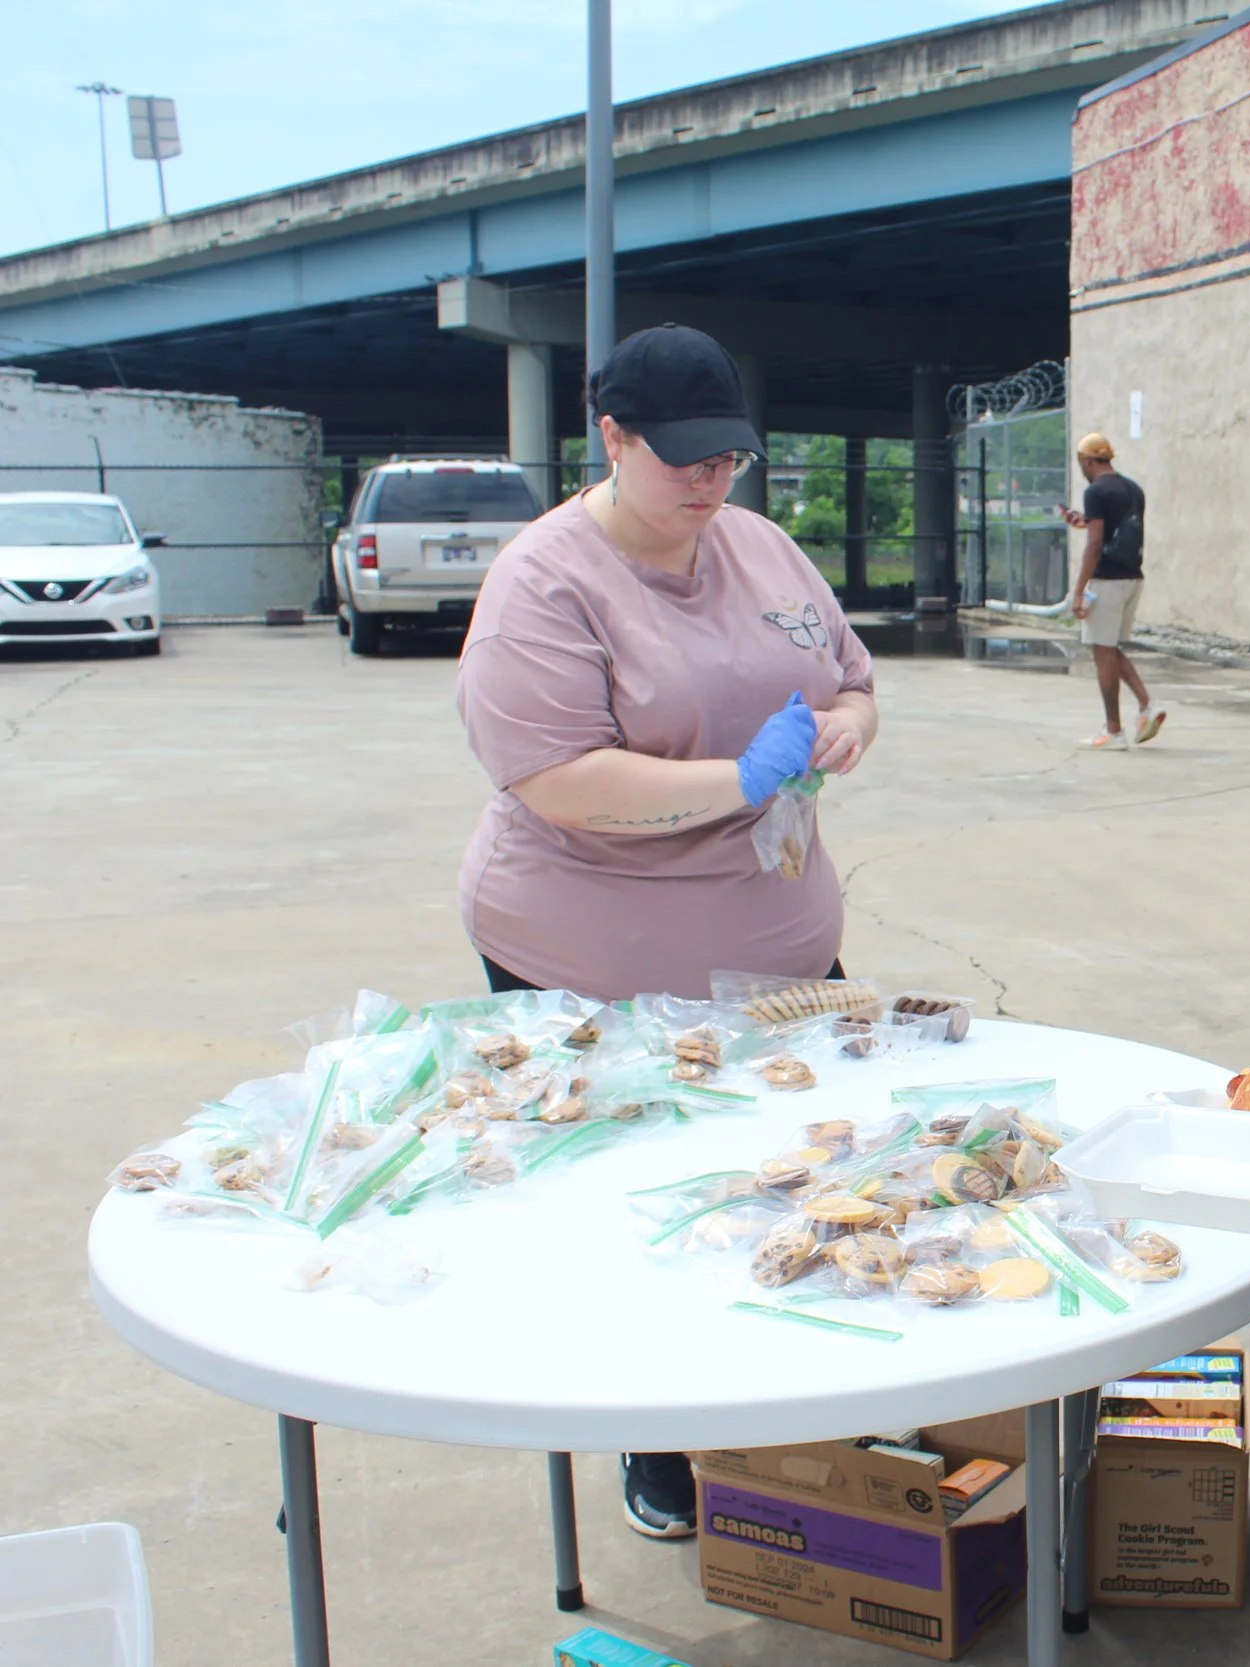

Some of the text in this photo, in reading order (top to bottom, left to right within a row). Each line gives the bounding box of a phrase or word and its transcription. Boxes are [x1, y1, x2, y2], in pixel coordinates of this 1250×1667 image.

[711, 1513, 806, 1552] samoas
[1118, 1522, 1195, 1535] The Girl Scout
[1118, 1534, 1155, 1544] Cookie
[706, 1585, 779, 1610] NOT FOR RESALE
